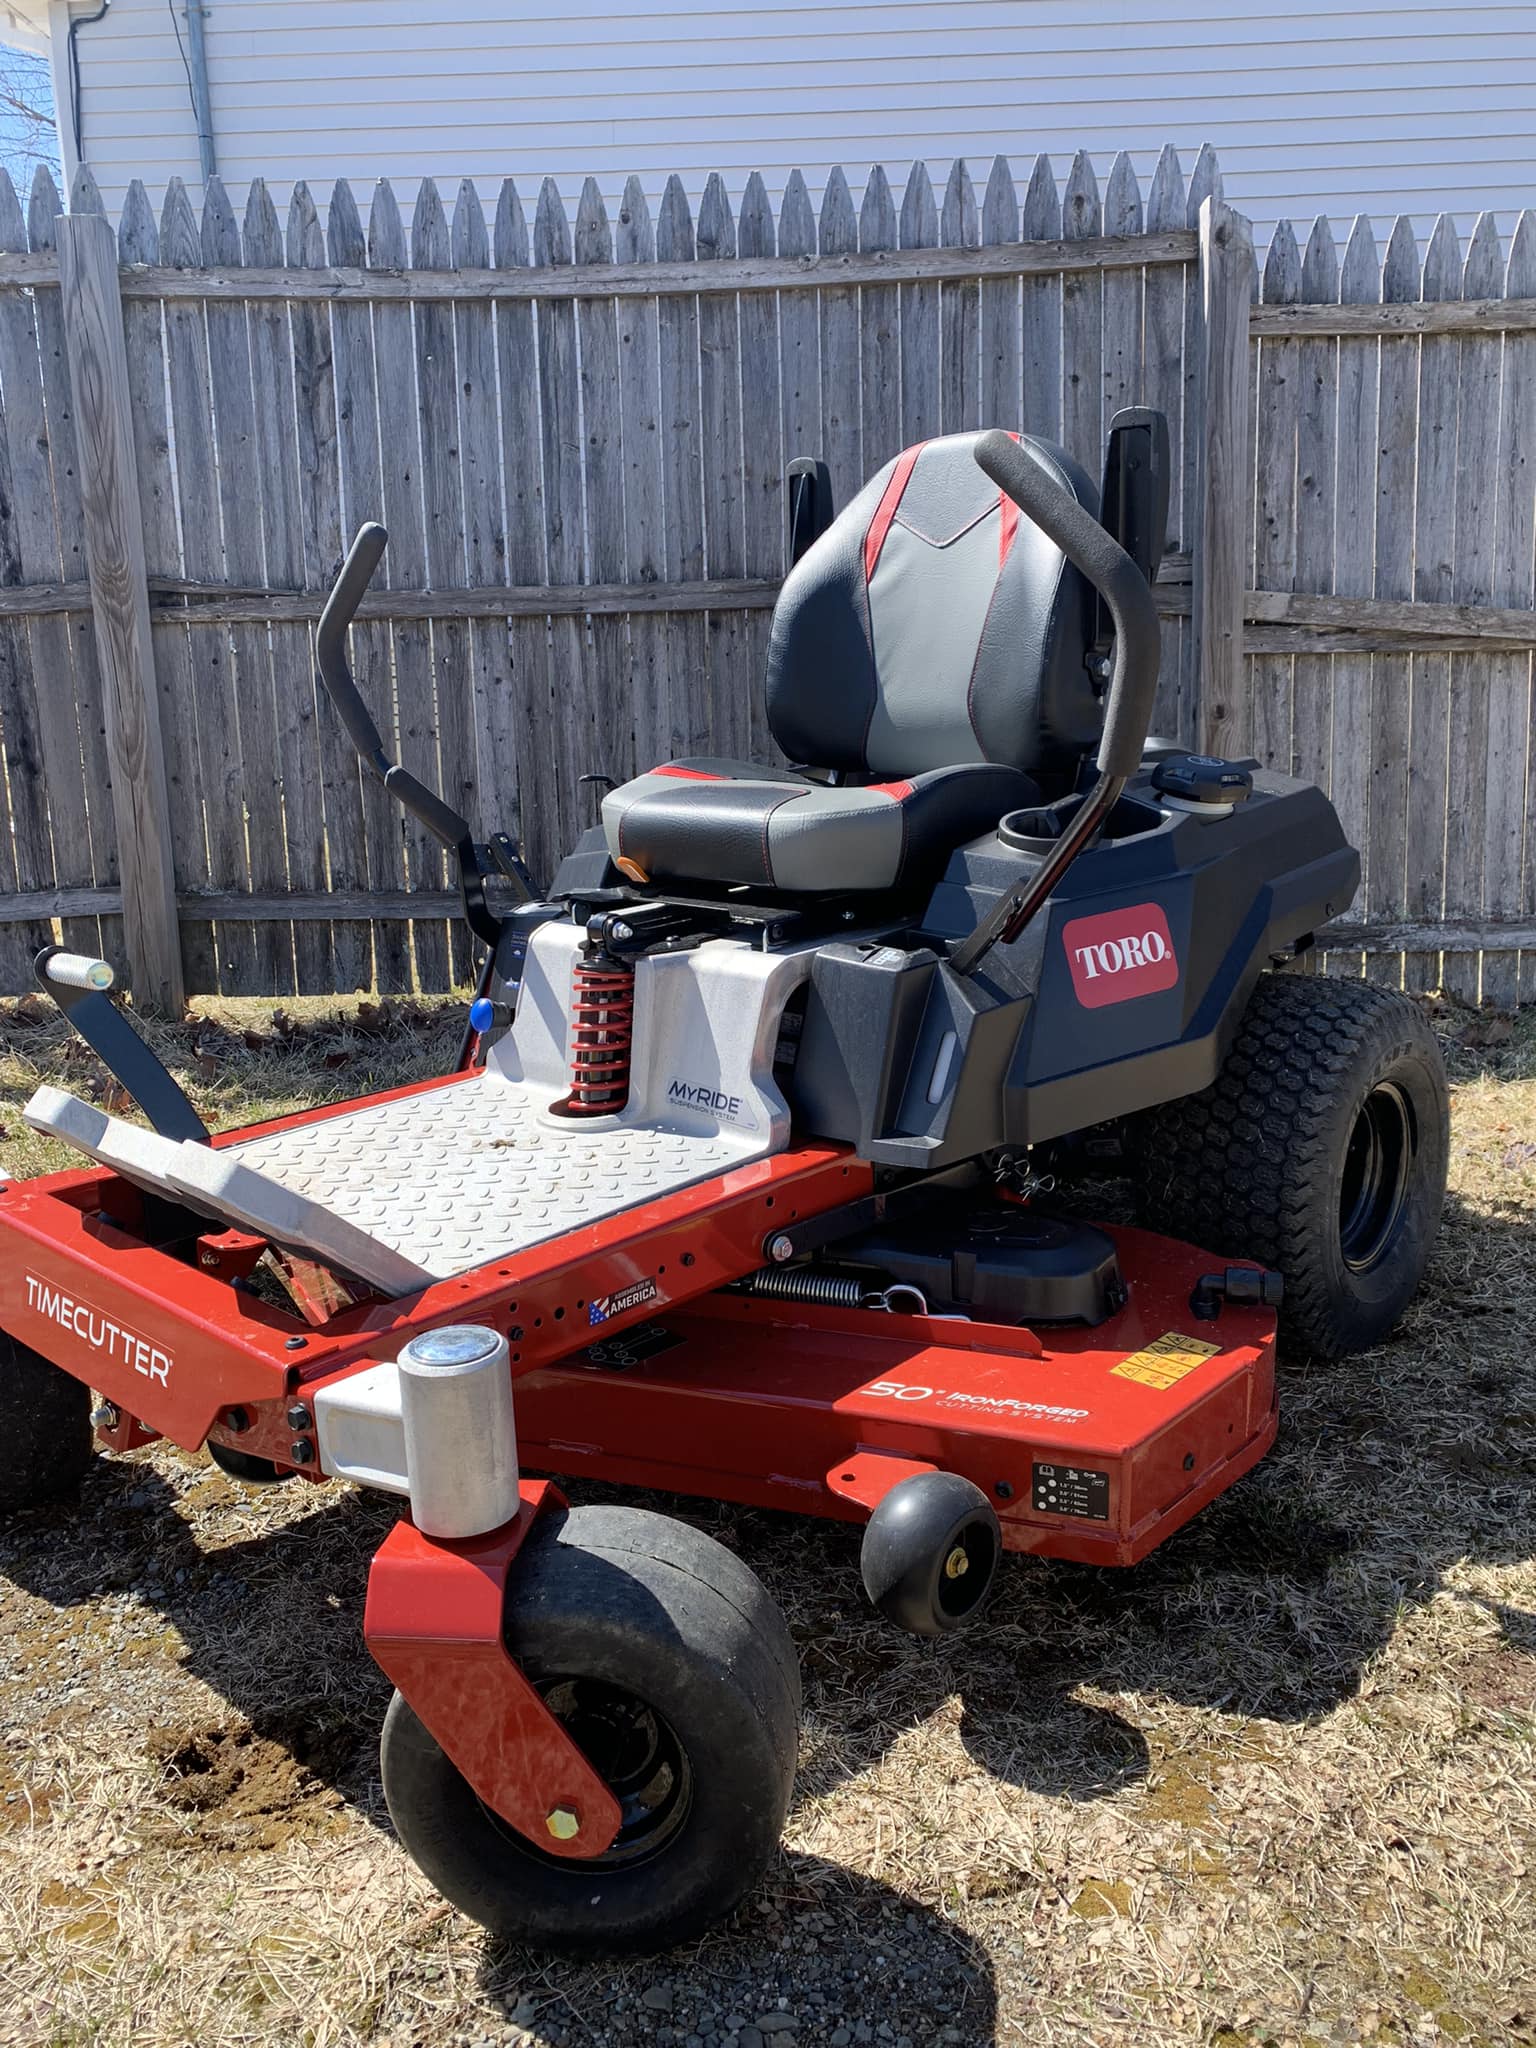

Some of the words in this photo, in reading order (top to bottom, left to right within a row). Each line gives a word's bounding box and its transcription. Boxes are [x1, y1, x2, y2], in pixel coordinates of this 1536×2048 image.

[1075, 930, 1165, 979] TORO
[670, 1098, 709, 1114] SUSPENSION
[710, 1110, 735, 1121] SYSTEM
[610, 1286, 656, 1314] AMERICA
[615, 1282, 645, 1299] ASSEMBLED
[25, 1275, 170, 1388] TIMECUTTER
[935, 1400, 1008, 1415] CUTTING
[1009, 1410, 1077, 1424] SYSTEM
